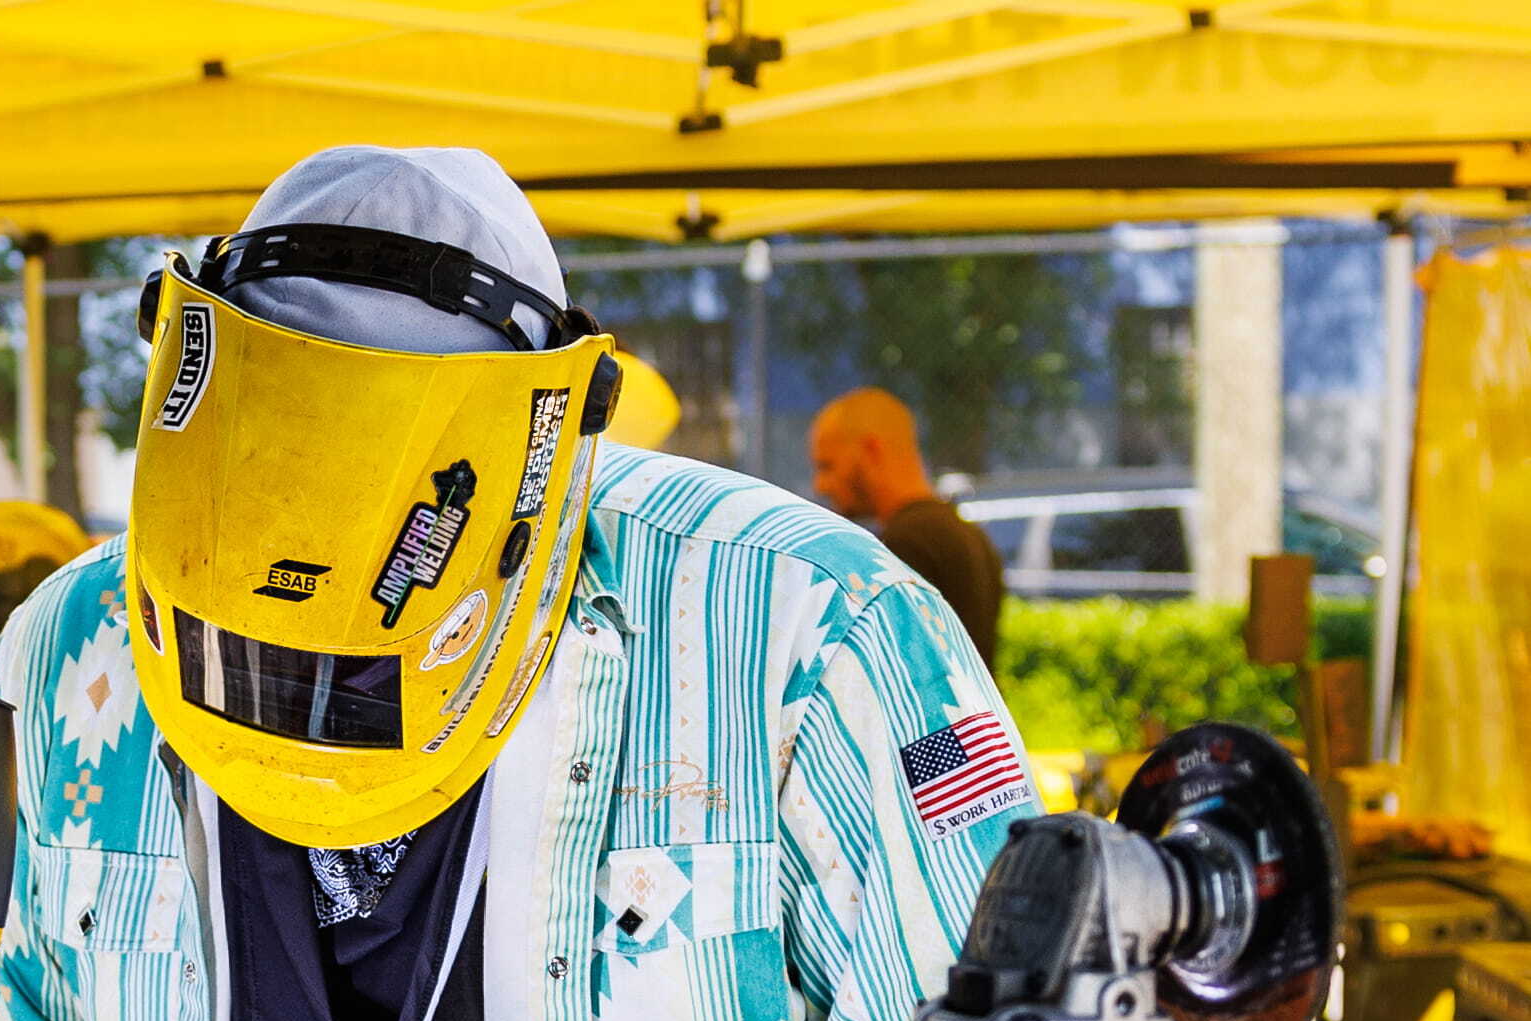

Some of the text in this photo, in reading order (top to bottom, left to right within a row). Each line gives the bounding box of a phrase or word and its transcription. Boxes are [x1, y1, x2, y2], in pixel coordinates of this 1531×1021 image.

[163, 313, 204, 419] SEND IT
[521, 397, 556, 512] BE DUMB
[531, 396, 545, 446] GUNNA
[267, 568, 317, 592] ESAB
[377, 508, 439, 605] AMPLIFIED
[412, 506, 464, 584] WELDING
[947, 802, 988, 828] WORK
